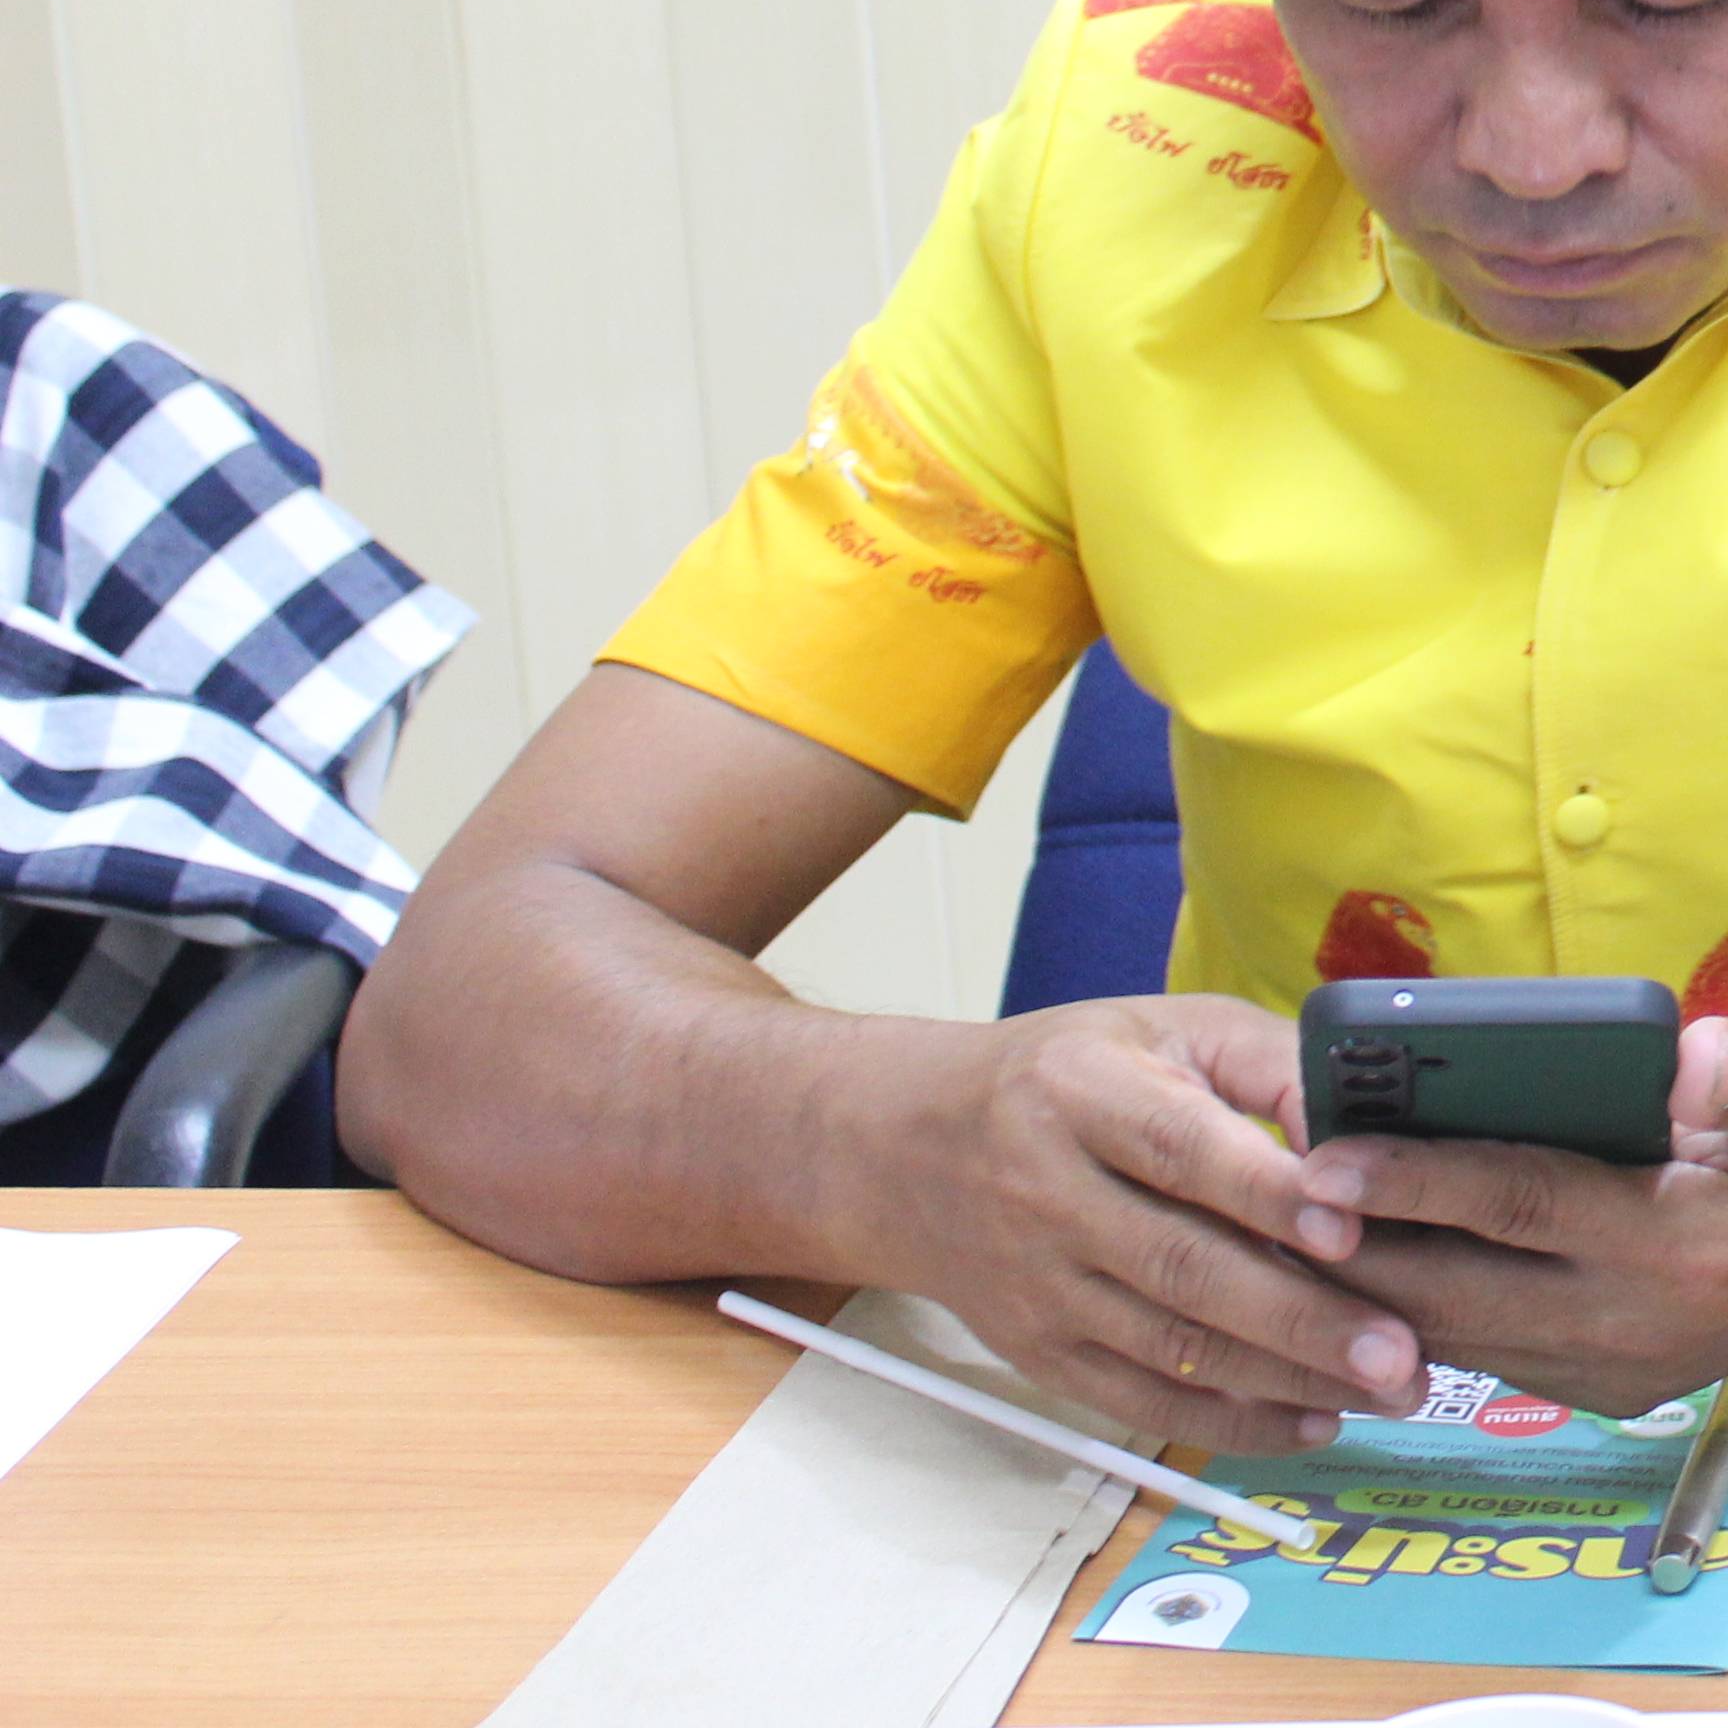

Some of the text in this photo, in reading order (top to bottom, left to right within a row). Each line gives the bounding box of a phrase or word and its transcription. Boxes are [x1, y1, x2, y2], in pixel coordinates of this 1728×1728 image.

[1364, 1492, 1619, 1517] การเลือก สว.
